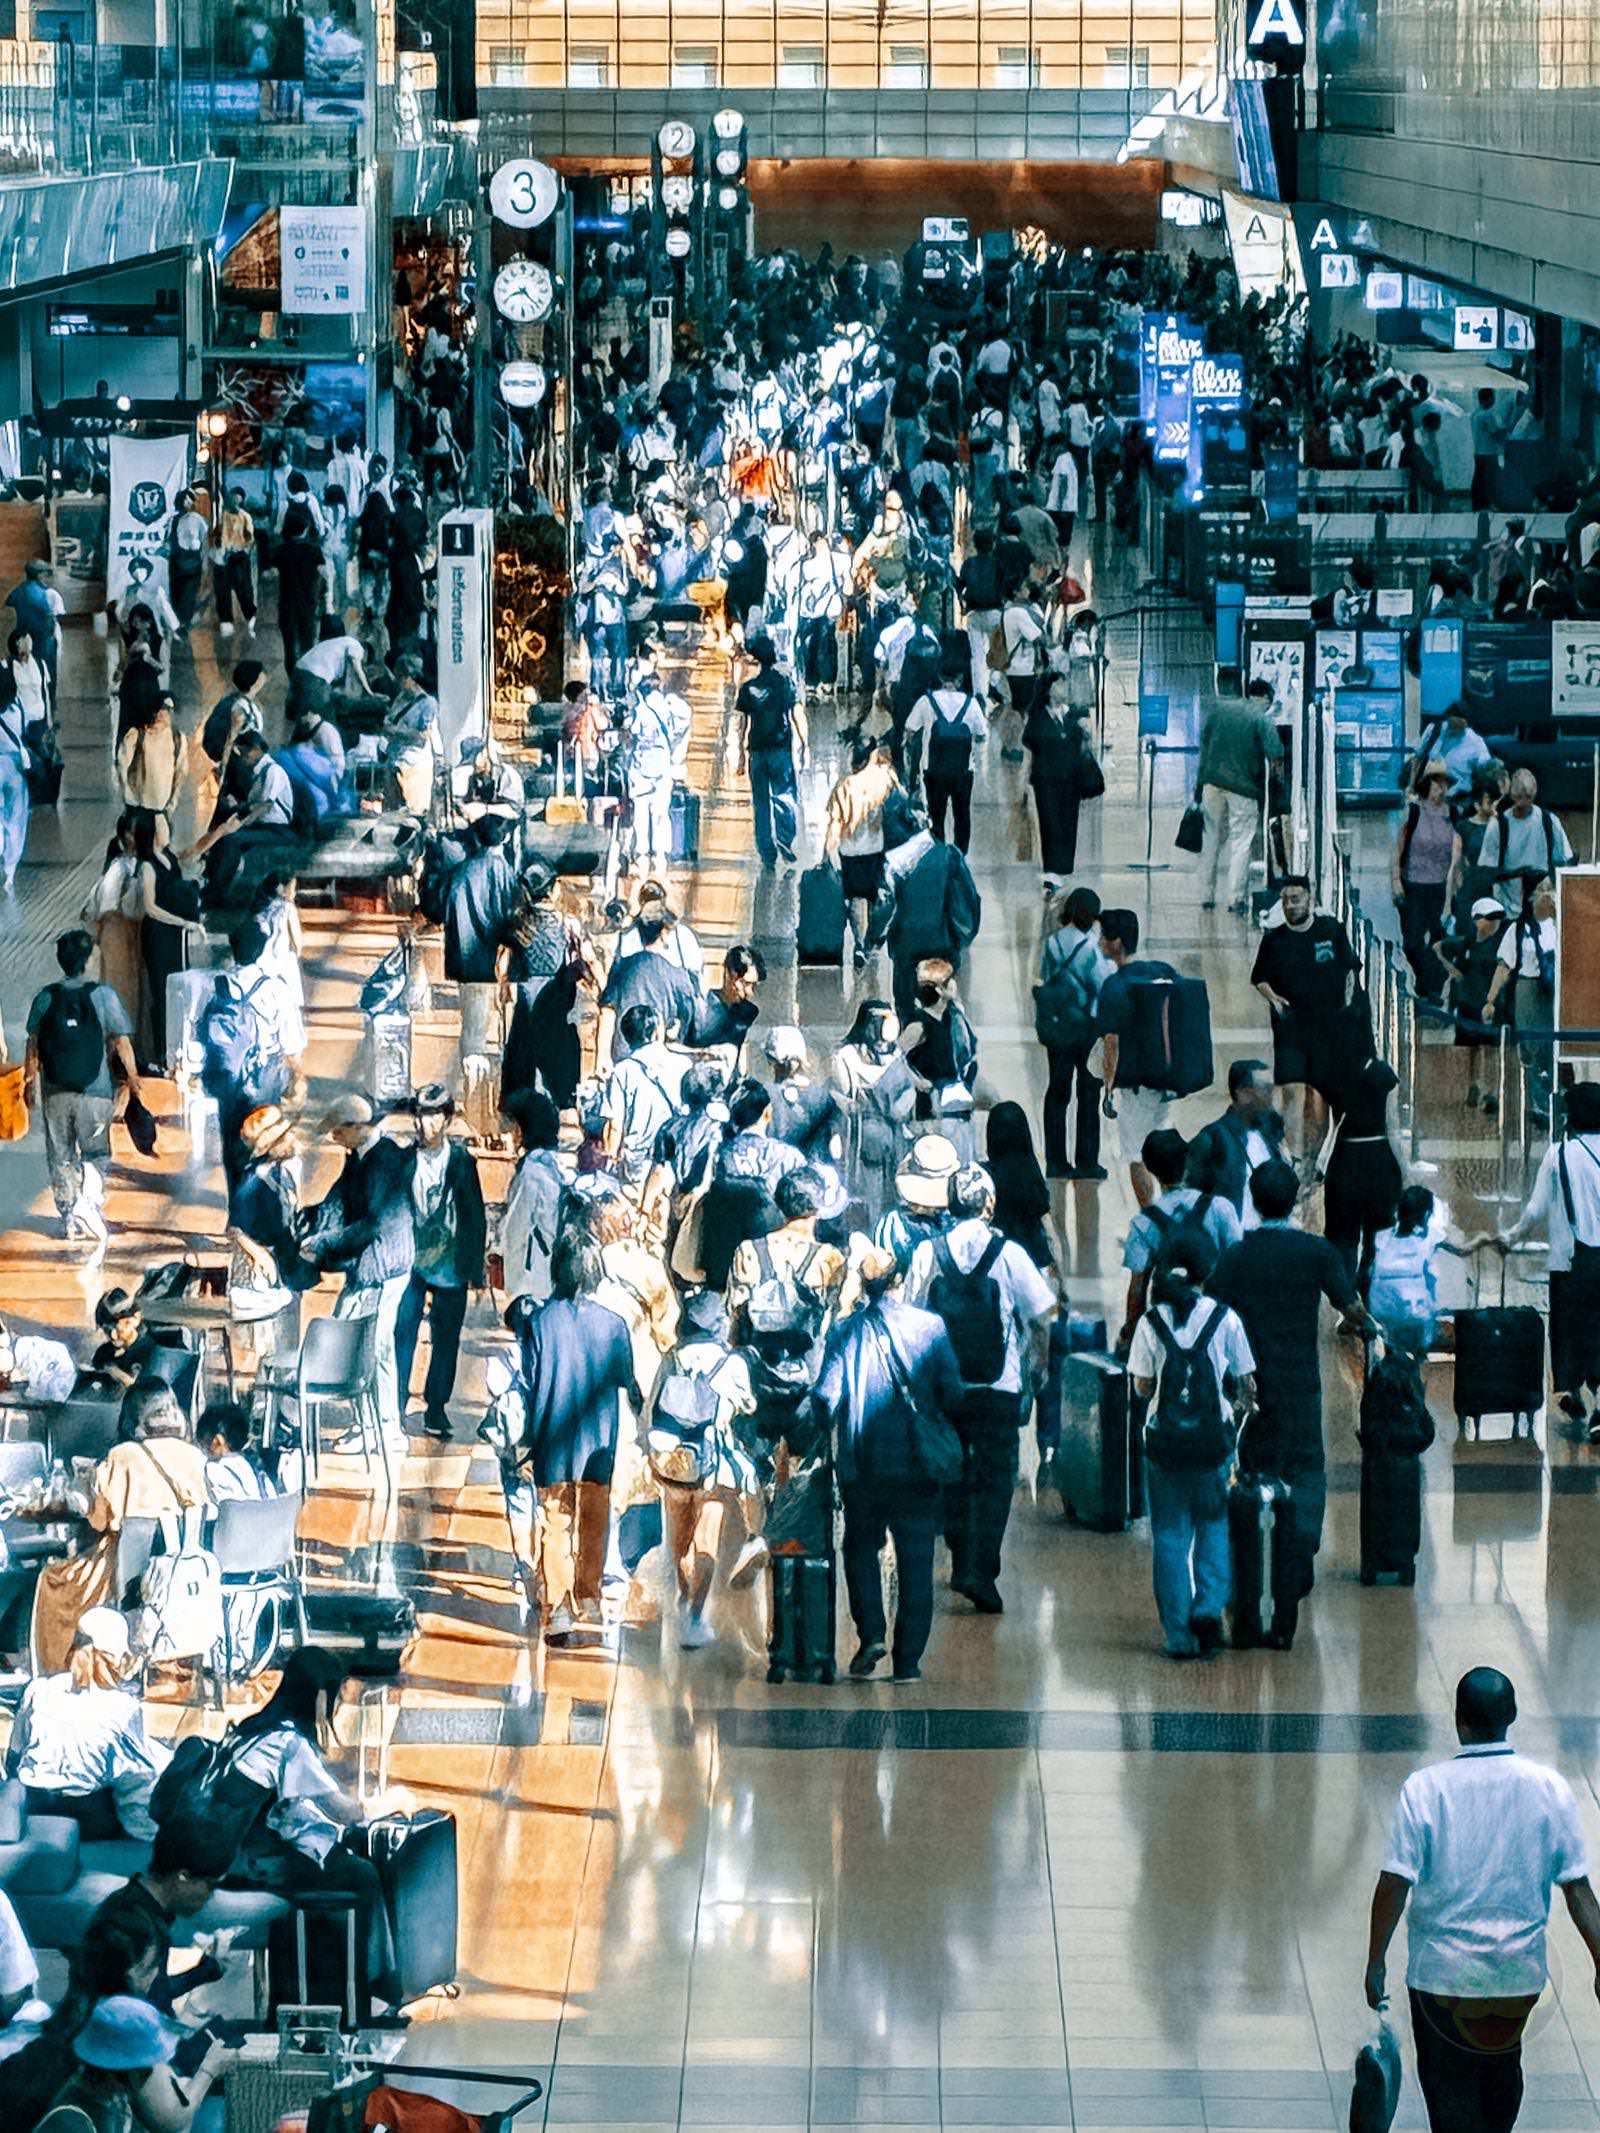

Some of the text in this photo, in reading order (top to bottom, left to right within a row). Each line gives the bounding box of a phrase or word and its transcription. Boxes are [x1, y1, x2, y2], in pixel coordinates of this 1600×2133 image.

[1249, 0, 1304, 44] A
[671, 126, 685, 152] 2
[510, 171, 536, 214] 3
[1246, 215, 1267, 241] A
[1310, 219, 1338, 250] A
